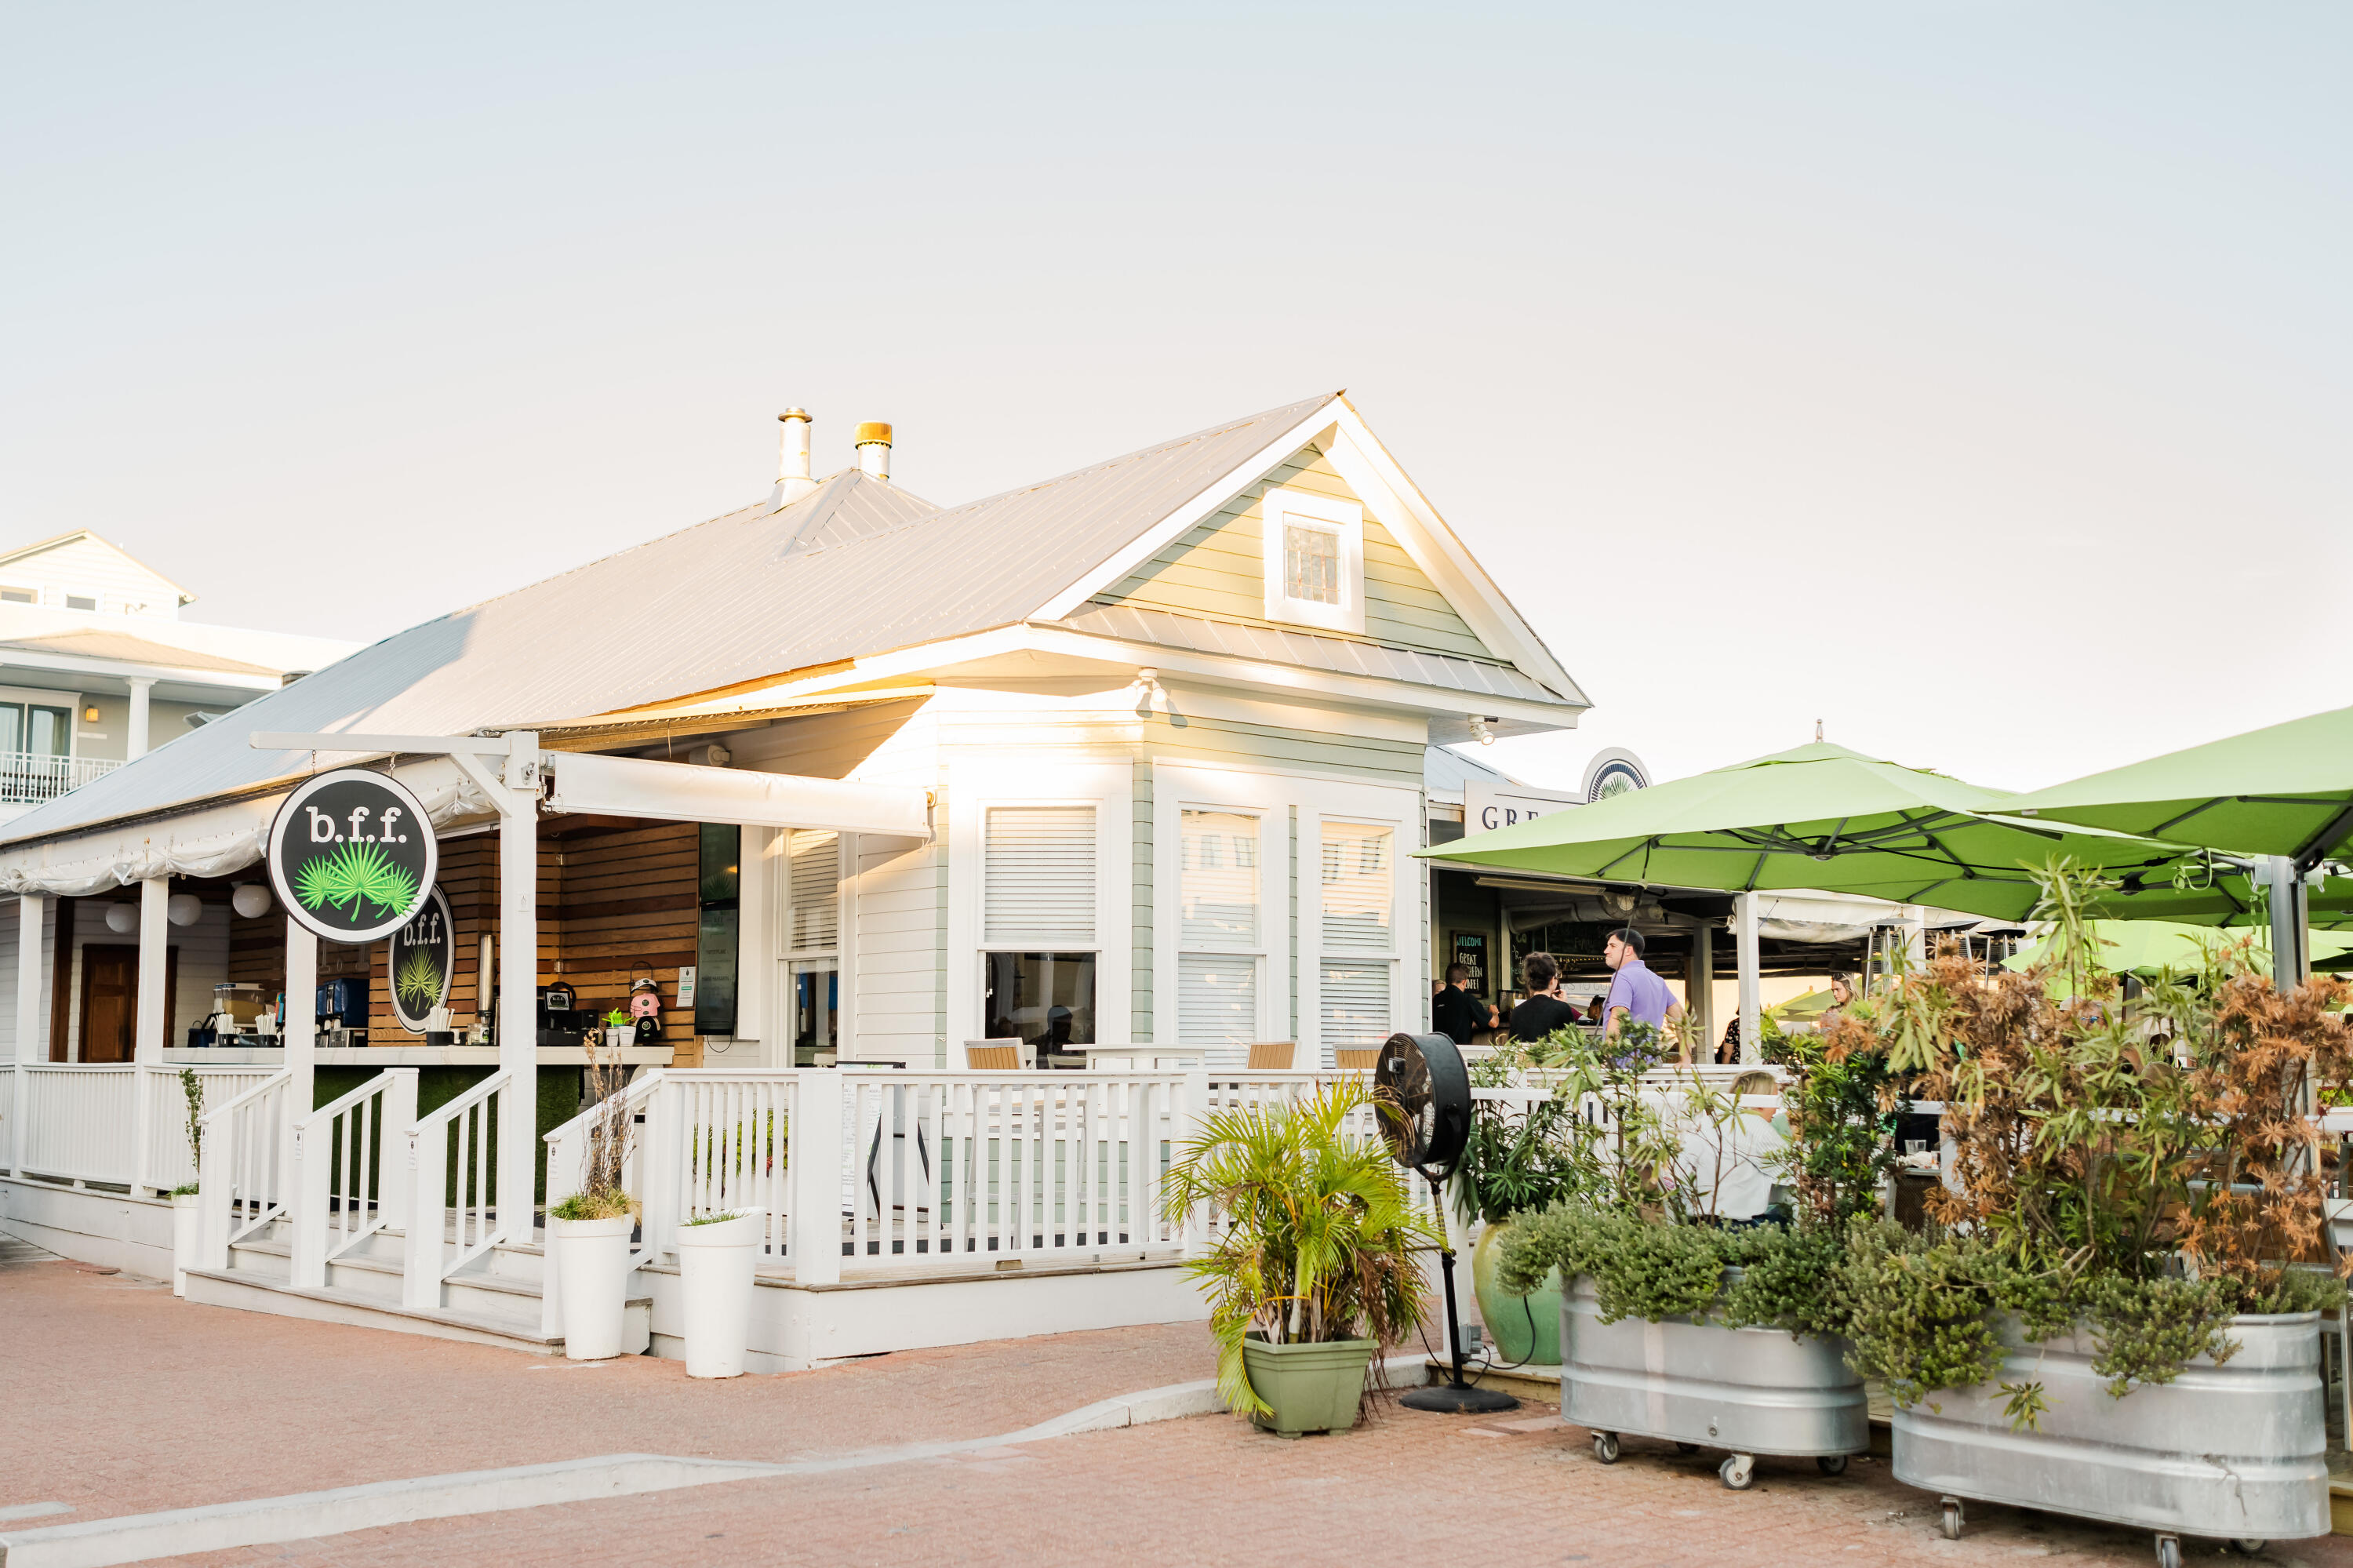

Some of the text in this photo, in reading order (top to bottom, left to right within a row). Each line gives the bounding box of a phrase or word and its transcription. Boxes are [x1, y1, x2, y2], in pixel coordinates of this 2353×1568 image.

[305, 806, 407, 843] b.f.f.
[1459, 952, 1477, 966] GREAT
[1467, 966, 1482, 977] HERN
[1464, 978, 1479, 991] AFE!
